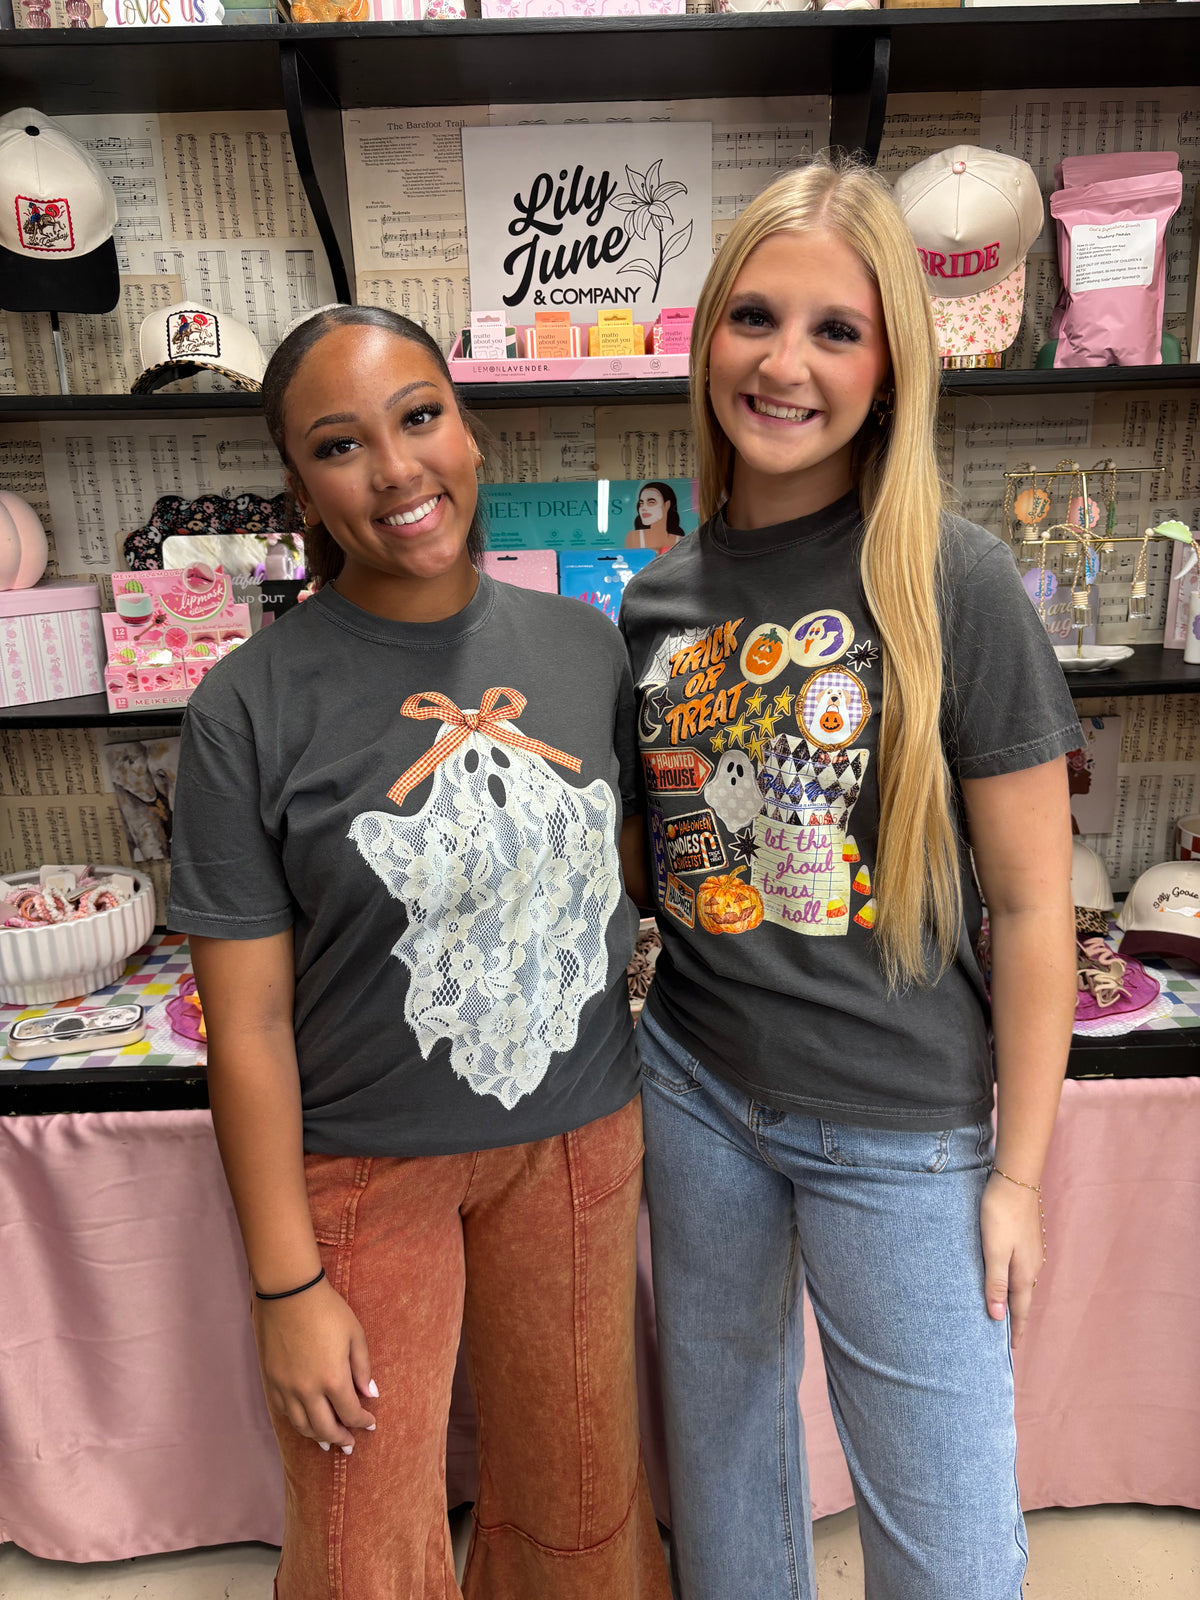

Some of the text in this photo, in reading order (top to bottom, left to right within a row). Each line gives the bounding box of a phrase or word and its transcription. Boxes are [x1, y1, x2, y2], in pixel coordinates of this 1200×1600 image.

[115, 0, 171, 25] Loves
[387, 122, 403, 130] The
[407, 121, 442, 129] Barefoot
[508, 165, 617, 236] Lily
[502, 226, 631, 307] June
[533, 286, 641, 305] & COMPANY
[480, 498, 623, 519] HEET DREAS
[258, 594, 285, 604] OUT
[669, 617, 746, 679] TRICK
[683, 663, 725, 700] OR
[665, 680, 749, 746] TREAT
[655, 753, 695, 769] HAUNTED
[659, 768, 696, 788] HOUSE
[762, 773, 802, 796] Thank
[668, 833, 700, 860] CANDIES
[764, 826, 832, 851] let the
[776, 849, 835, 880] ghoul
[1171, 886, 1199, 900] Goose
[782, 900, 823, 924] roll
